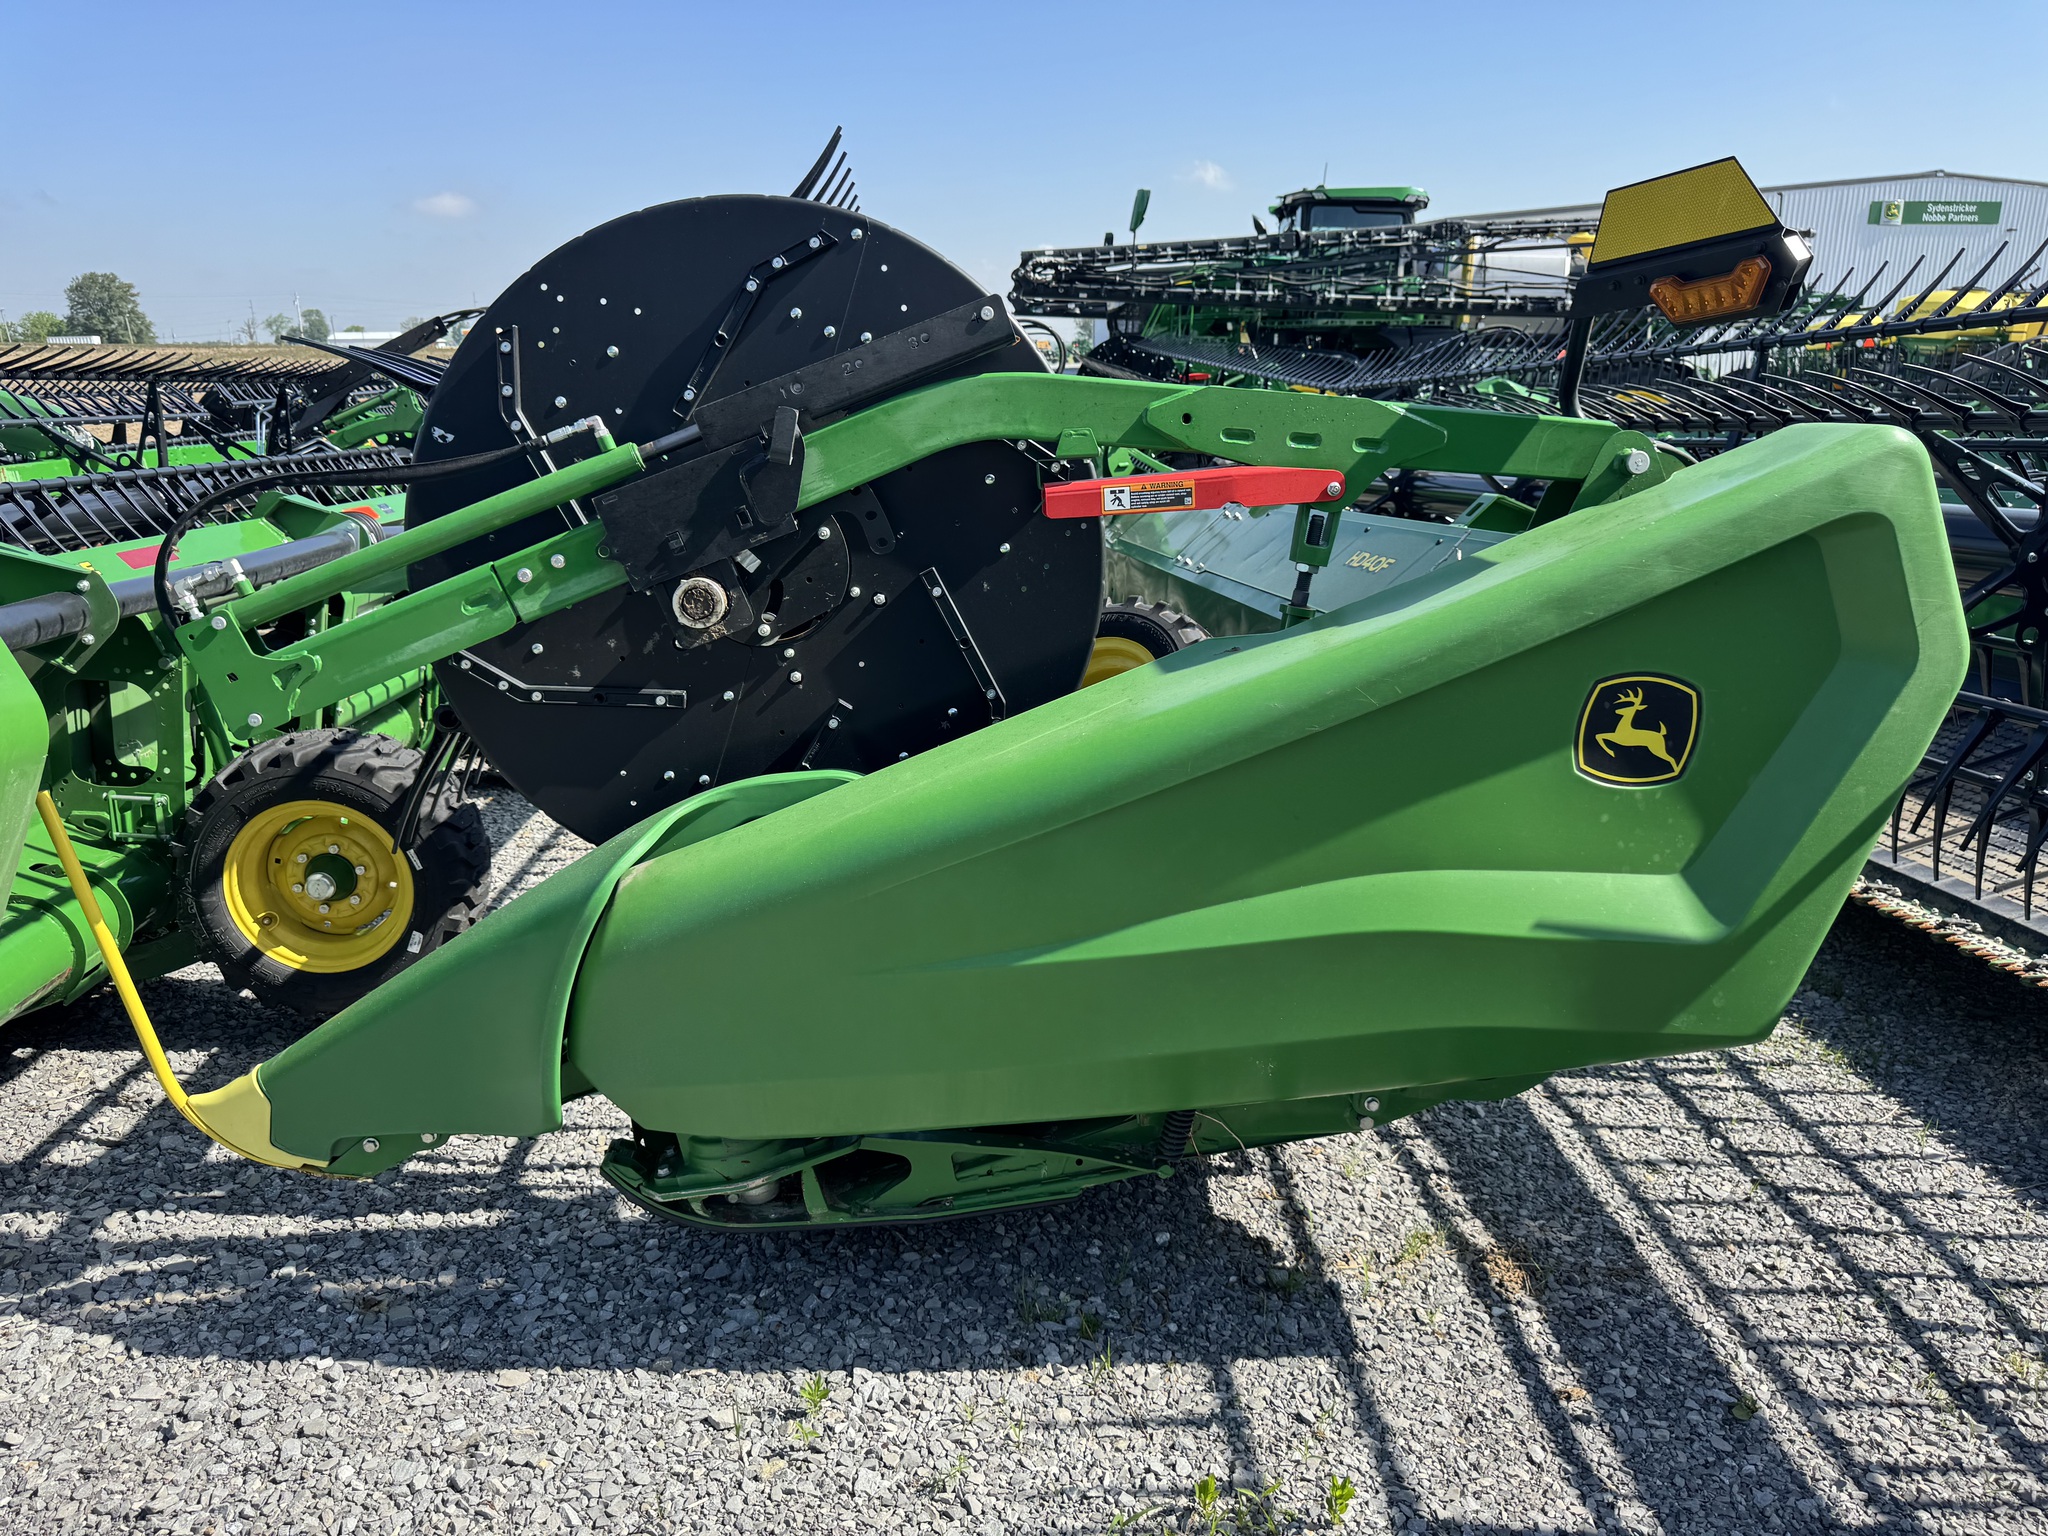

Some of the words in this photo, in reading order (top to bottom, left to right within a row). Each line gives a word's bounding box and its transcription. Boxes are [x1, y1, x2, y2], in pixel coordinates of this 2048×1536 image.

[1926, 203, 1977, 214] Sydenstricker
[1922, 213, 1946, 222] Nobbe
[1947, 213, 1979, 222] Partners
[1149, 481, 1184, 489] WARNING
